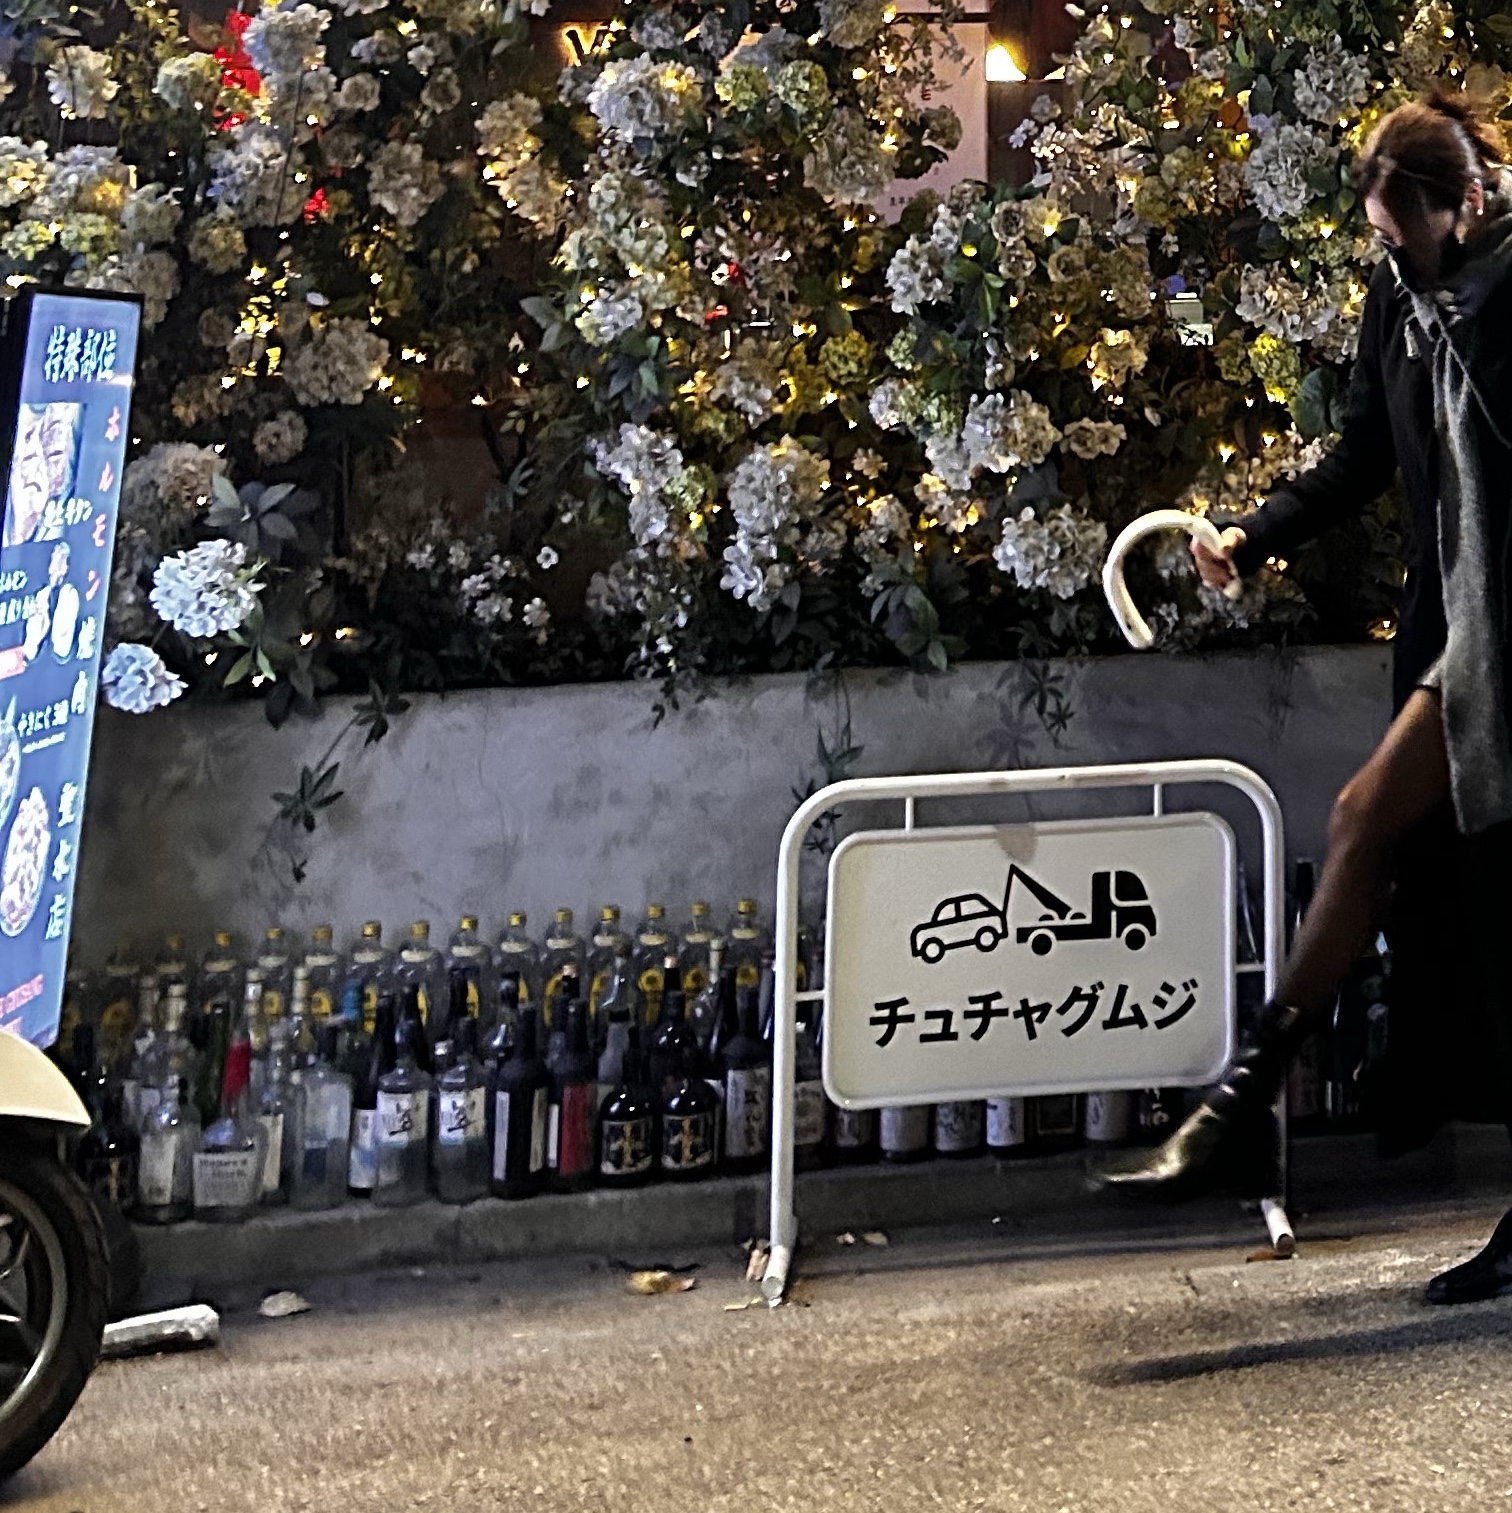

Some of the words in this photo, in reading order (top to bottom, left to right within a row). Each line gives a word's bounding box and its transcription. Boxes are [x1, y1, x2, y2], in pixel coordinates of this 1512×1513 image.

[868, 978, 1199, 1048] チュチャグムジ
